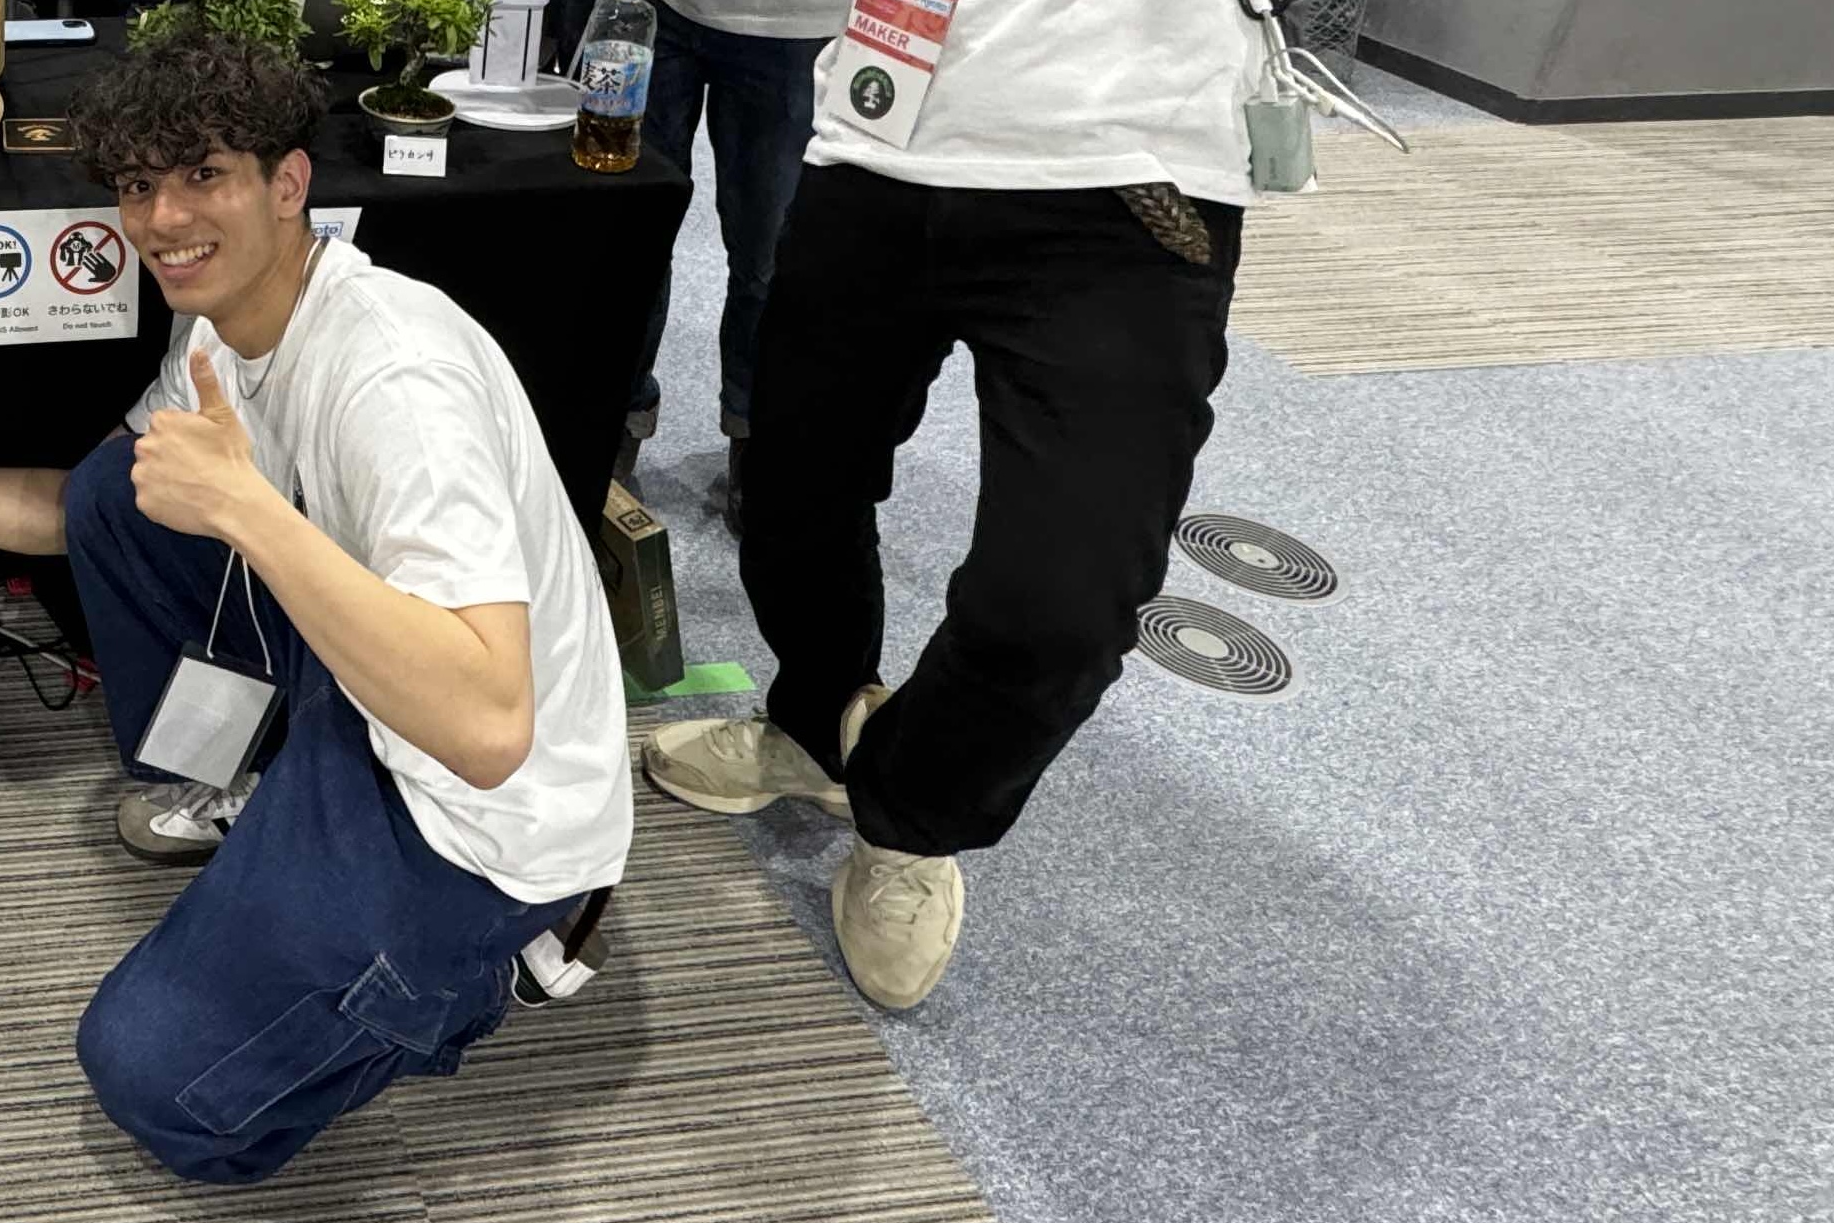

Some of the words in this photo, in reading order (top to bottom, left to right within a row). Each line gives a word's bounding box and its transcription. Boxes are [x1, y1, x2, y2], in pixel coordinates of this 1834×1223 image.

[854, 15, 911, 50] MAKER
[47, 302, 128, 316] さわらないでね
[9, 325, 39, 333] Allowed
[75, 321, 88, 329] not
